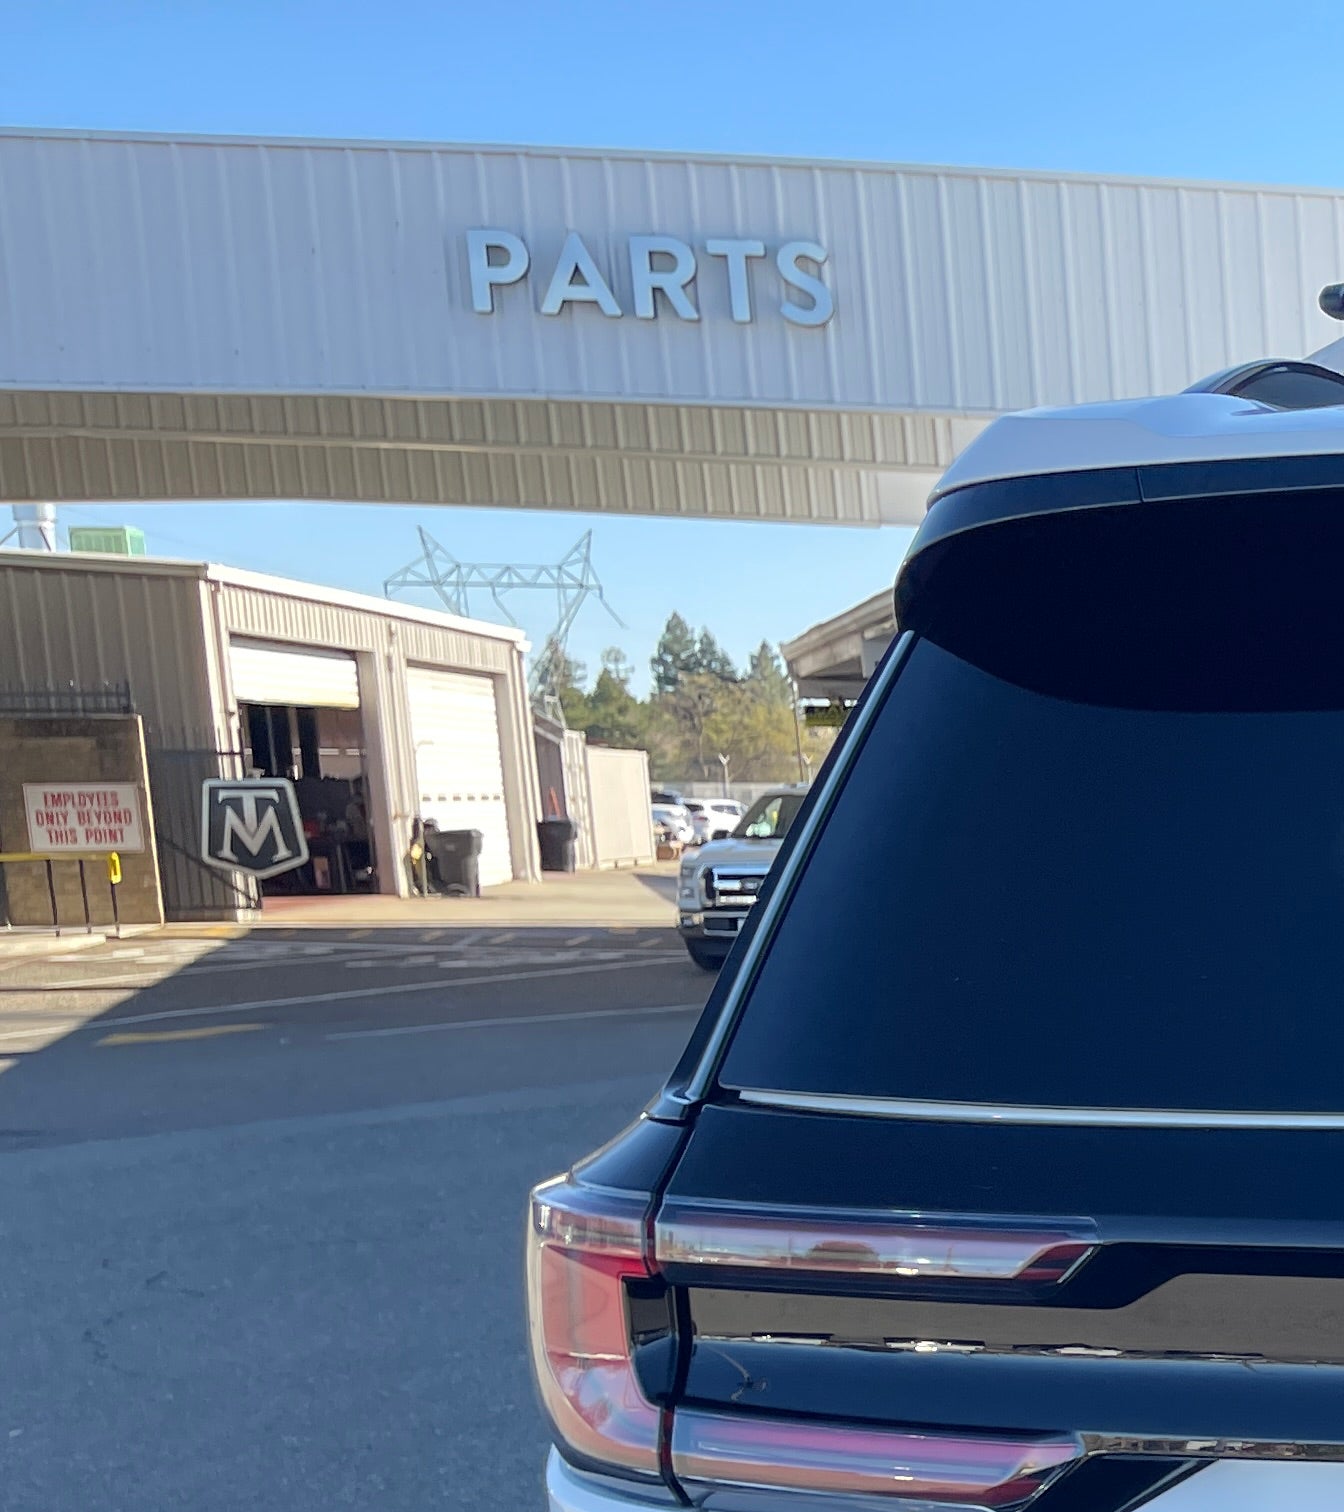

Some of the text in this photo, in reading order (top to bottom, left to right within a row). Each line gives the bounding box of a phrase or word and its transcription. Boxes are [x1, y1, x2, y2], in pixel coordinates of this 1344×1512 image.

[466, 229, 835, 327] PARTS
[42, 790, 120, 807] EMPLOYEES
[35, 808, 133, 826] ONLY BEYOND
[46, 828, 126, 845] THIS POINT
